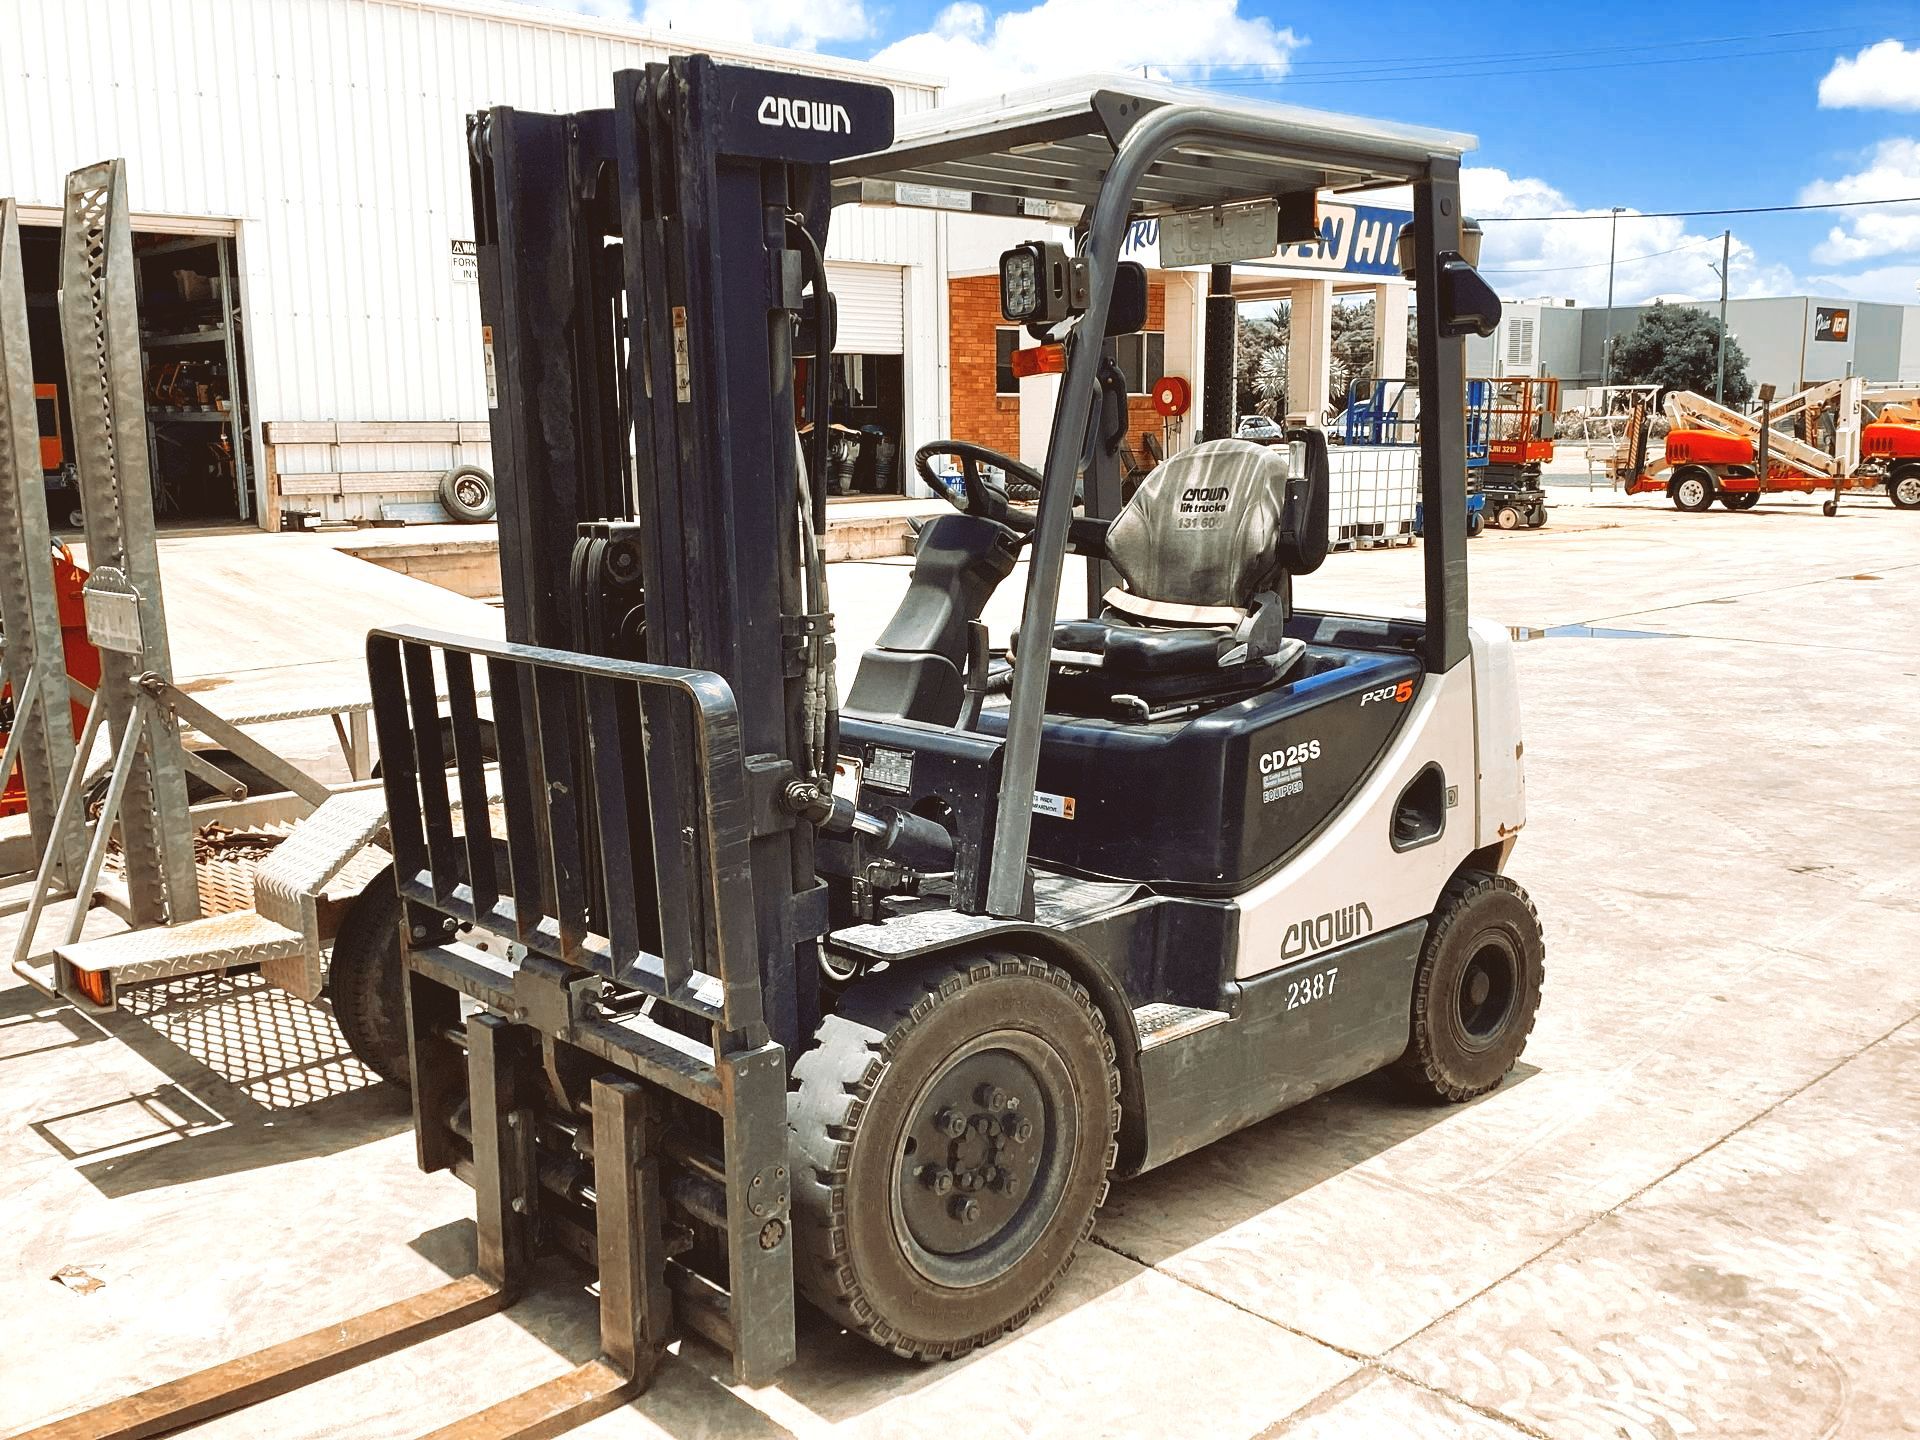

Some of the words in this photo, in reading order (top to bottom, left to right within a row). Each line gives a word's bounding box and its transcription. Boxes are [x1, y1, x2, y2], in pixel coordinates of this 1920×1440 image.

[757, 95, 851, 135] CROWN
[1502, 445, 1517, 453] 3219
[1182, 486, 1229, 502] CROWN
[1180, 503, 1193, 513] lift
[1194, 502, 1227, 513] trucks
[1178, 518, 1198, 529] 131
[70, 568, 82, 583] 4
[1263, 780, 1304, 804] EQUIPPED
[1280, 901, 1373, 960] CROWN
[1287, 967, 1339, 1011] 2387
